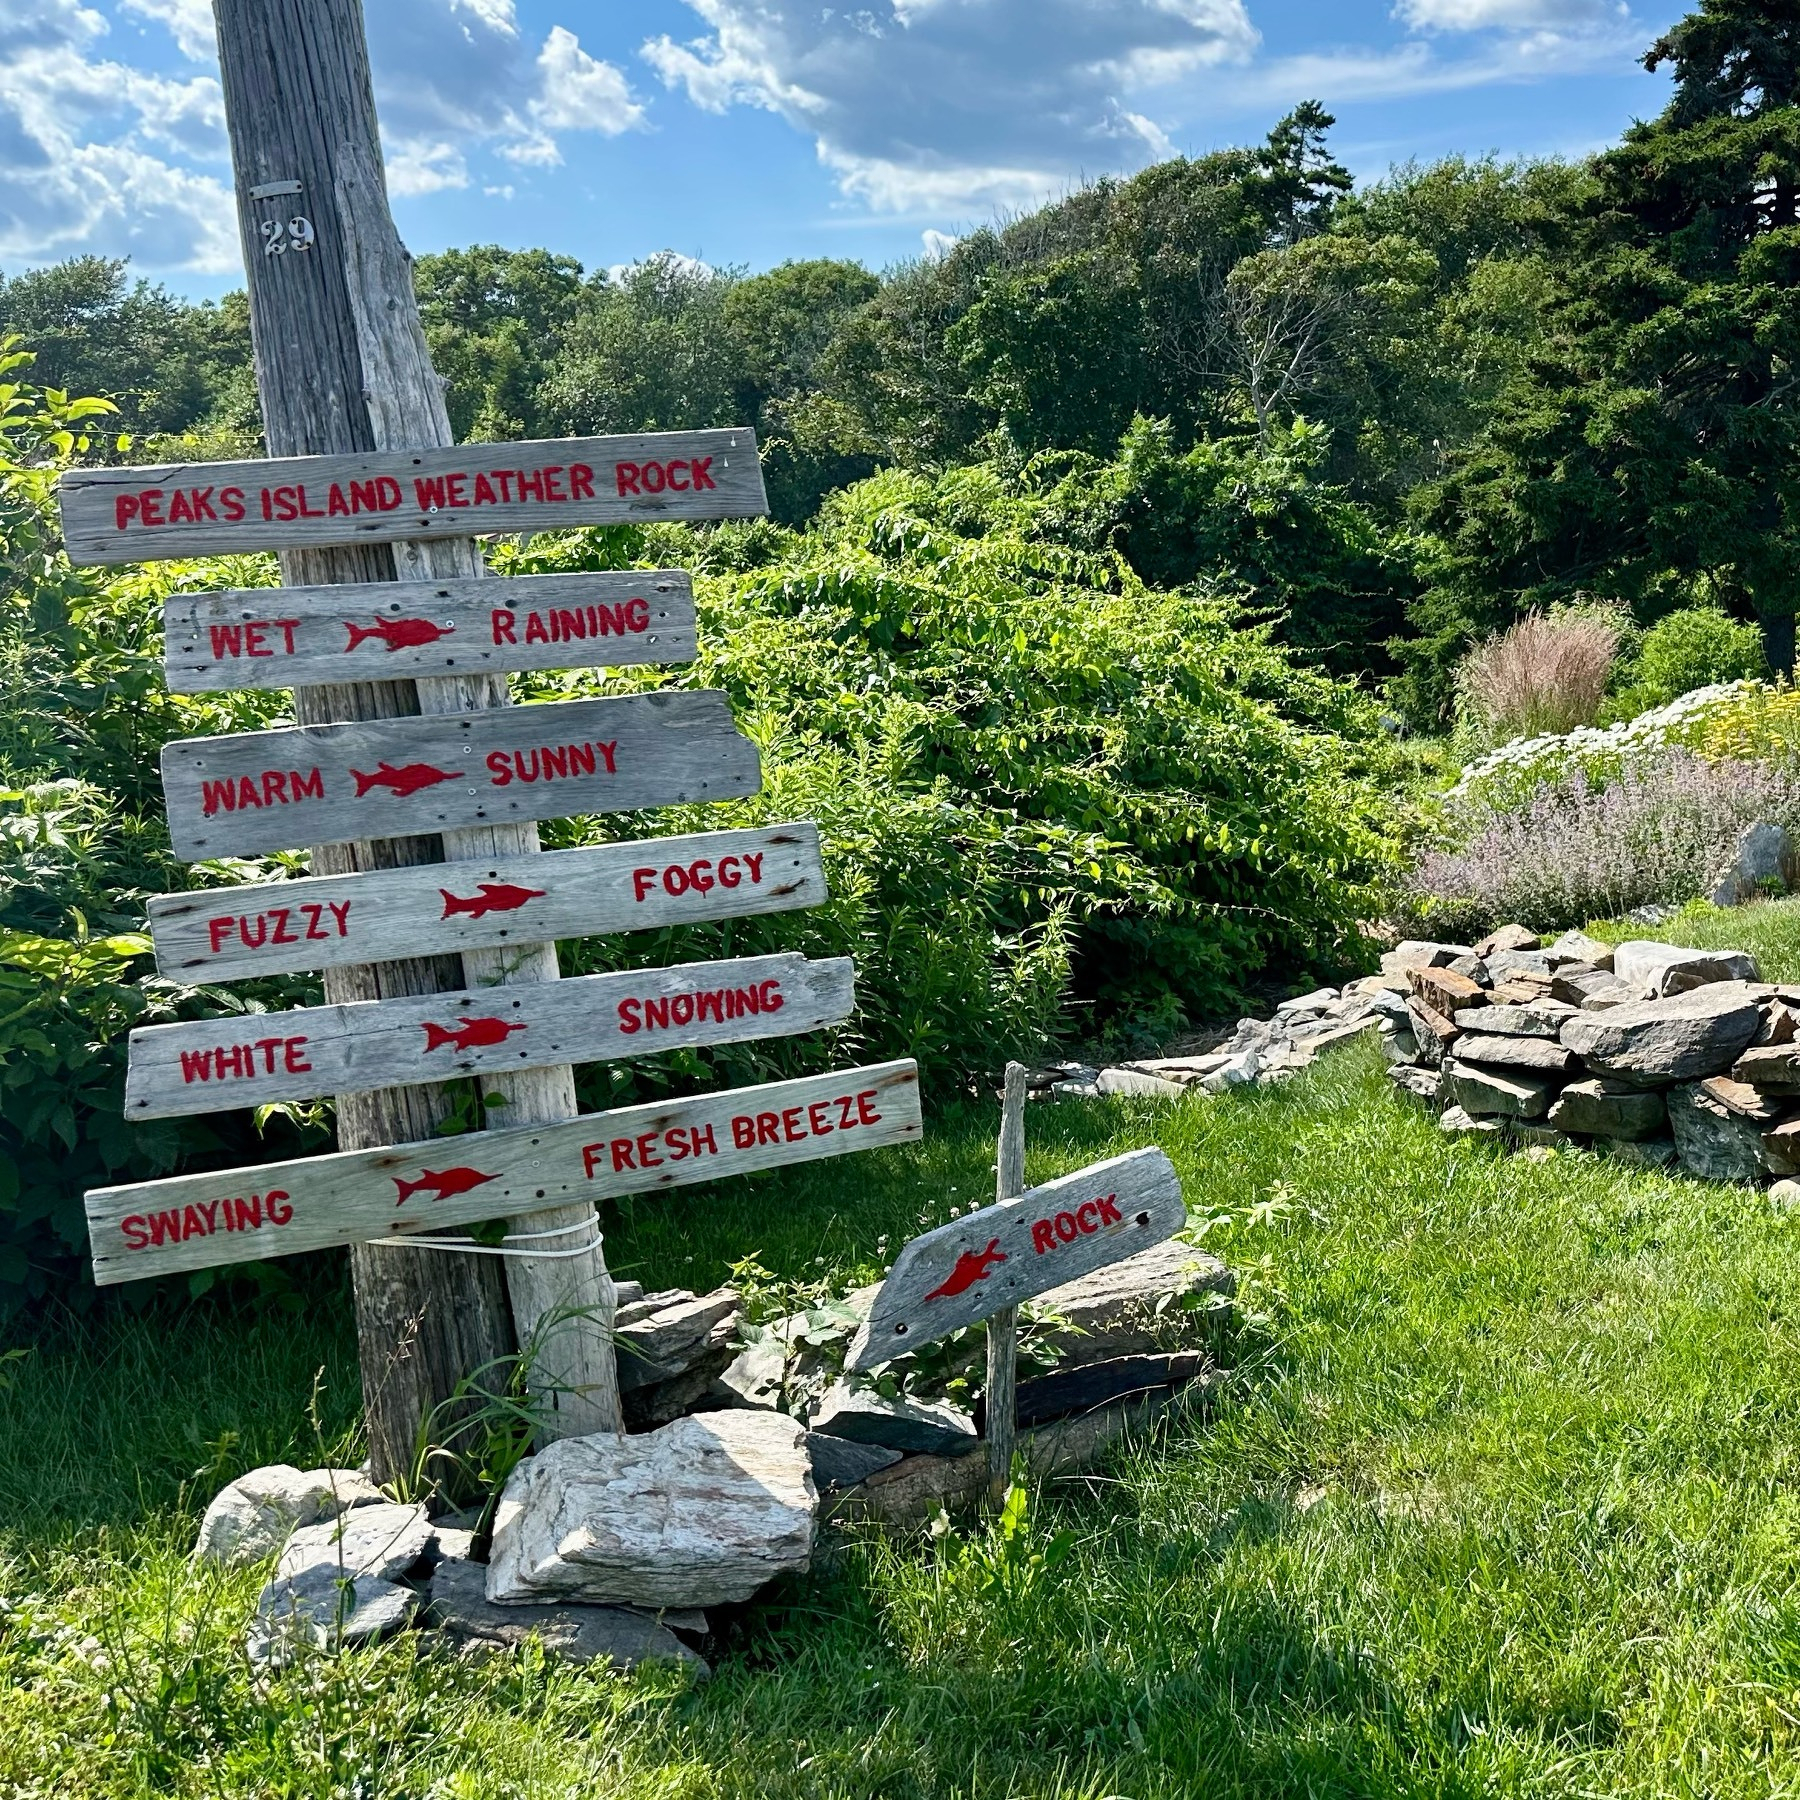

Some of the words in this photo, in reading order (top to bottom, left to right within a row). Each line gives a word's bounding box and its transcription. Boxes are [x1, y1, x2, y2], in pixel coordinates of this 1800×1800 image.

[261, 217, 315, 255] 29
[116, 486, 246, 530] PEAKS
[260, 476, 403, 522] ISLAND
[415, 464, 595, 511] WEATHER
[616, 456, 717, 496] ROCK
[209, 619, 301, 661] WET
[491, 598, 650, 645] RAINING
[202, 767, 325, 816] WARM
[486, 740, 619, 788] SUNNY
[208, 900, 352, 953] FUZZY
[633, 852, 764, 902] FOGGY
[180, 1036, 312, 1084] WHITE
[617, 980, 784, 1035] SNOWING
[120, 1189, 294, 1251] SWAYING
[582, 1125, 718, 1180] FRESH
[731, 1089, 882, 1150] BREEZE
[1031, 1193, 1122, 1254] ROCK
